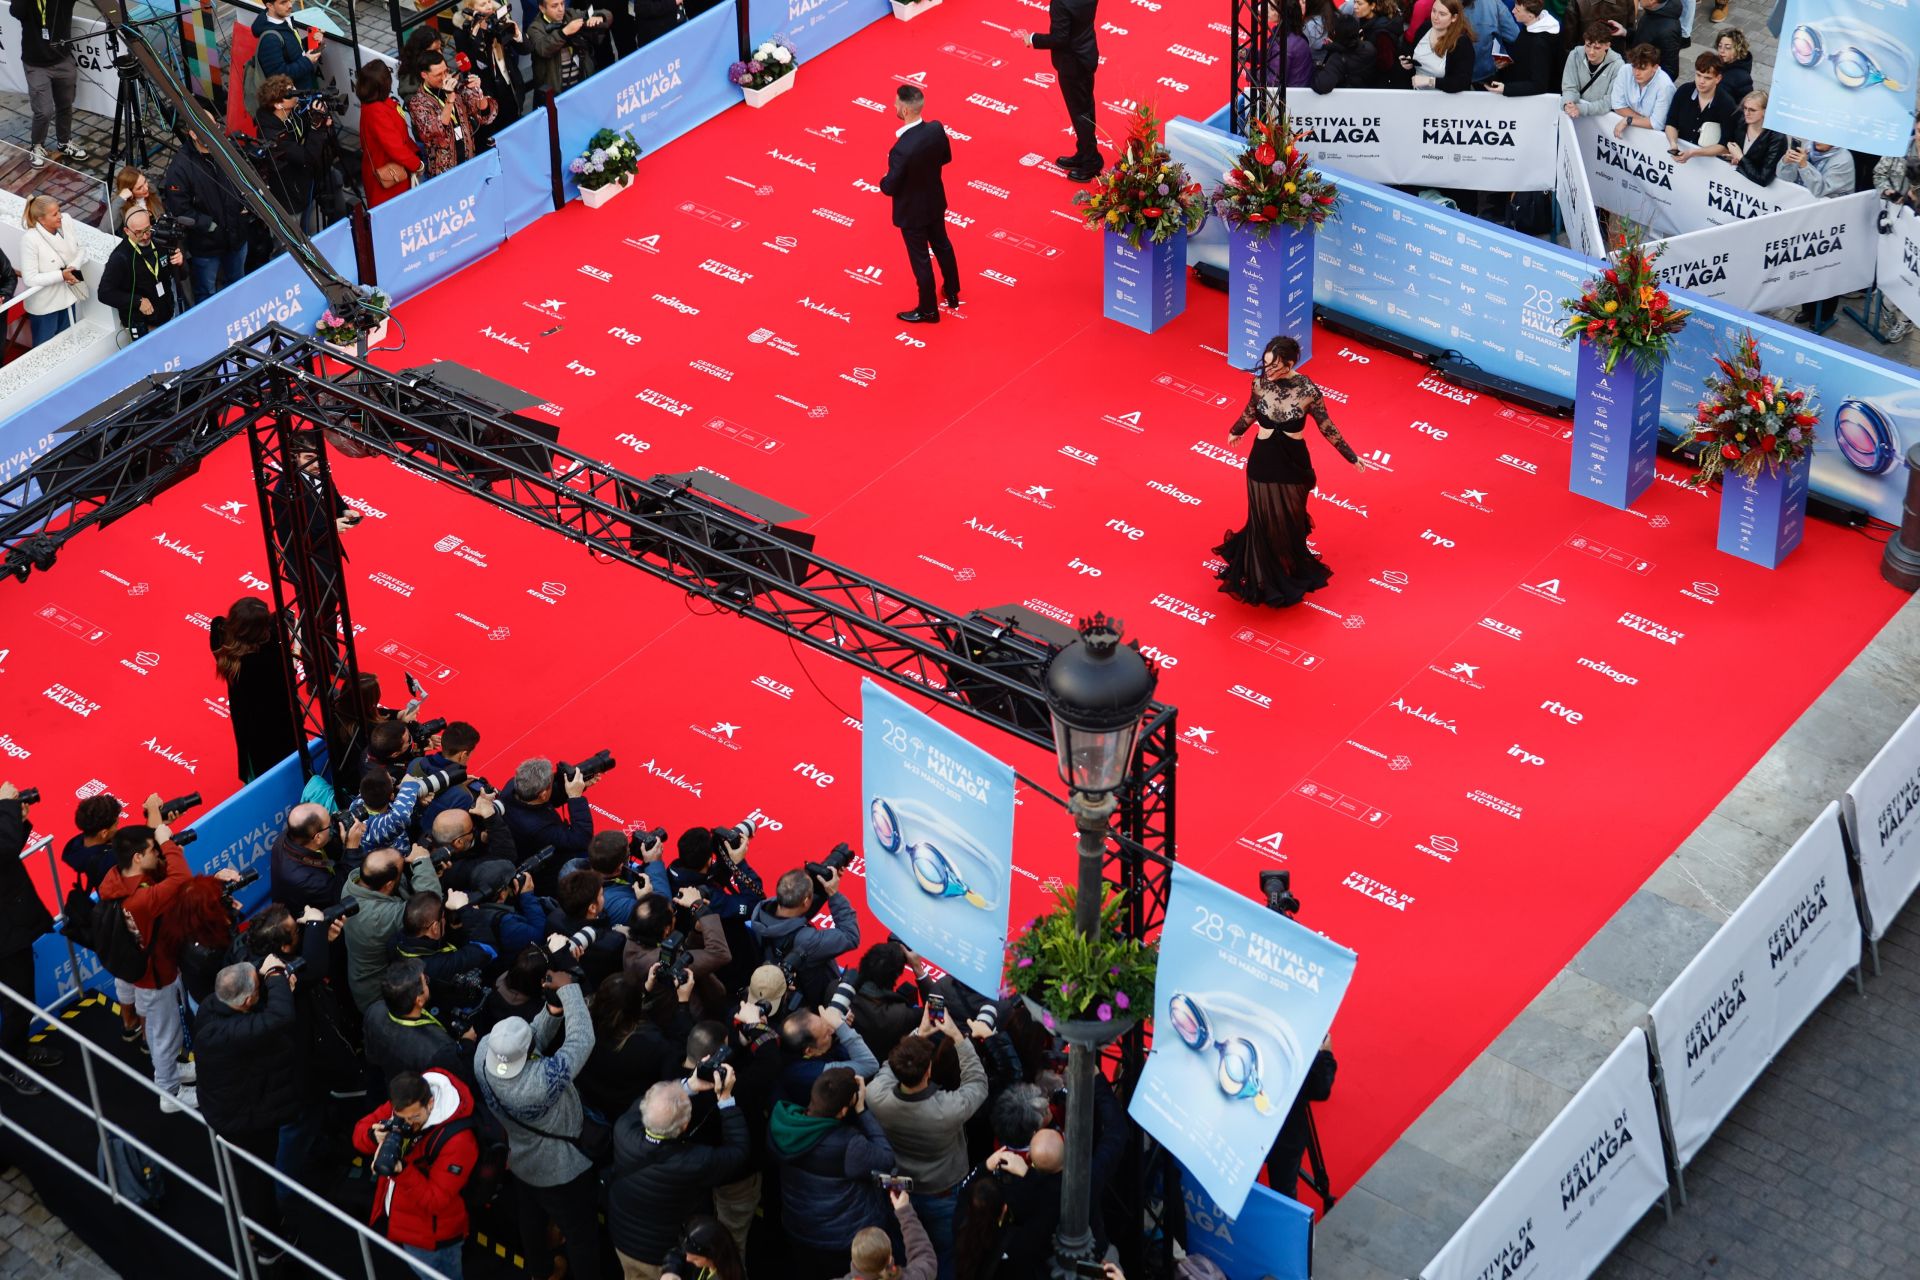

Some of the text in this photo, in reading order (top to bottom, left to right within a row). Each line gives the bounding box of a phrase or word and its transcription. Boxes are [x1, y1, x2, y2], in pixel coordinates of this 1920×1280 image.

[1101, 22, 1128, 35] iryo
[1172, 44, 1205, 57] FESTIVAL
[617, 58, 680, 102] FESTIVAL DE
[1157, 77, 1189, 92] rtve
[856, 98, 886, 110] SUR
[972, 93, 1005, 106] FESTIVAL
[1363, 117, 1381, 127] DE
[1423, 118, 1517, 130] FESTIVAL DE
[1422, 128, 1515, 146] MÁLAGA
[768, 149, 816, 172] Andalucía
[1598, 134, 1674, 174] FESTIVAL DE
[1596, 146, 1672, 190] MÁLAGA
[853, 179, 880, 192] iryo
[968, 182, 1008, 199] VICTORIA
[1709, 180, 1768, 211] FESTIVAL
[400, 194, 476, 240] FESTIVAL DE
[1708, 192, 1767, 220] MÁLA
[812, 210, 853, 227] VICTORIA
[1406, 242, 1422, 256] rtve
[1766, 224, 1846, 252] FESTIVAL DE
[1764, 236, 1842, 269] MÁLAGA
[581, 265, 612, 279] SUR
[705, 259, 739, 275] FESTIVAL
[984, 270, 1016, 284] SUR
[1656, 253, 1729, 279] ESTIVAL DE
[226, 284, 300, 336] FESTIVAL DE
[652, 294, 700, 315] málaga
[799, 297, 850, 322] Andalucía
[1523, 284, 1553, 314] 28
[480, 326, 530, 353] Andalucía
[608, 327, 641, 345] rtve
[896, 332, 925, 347] iryo
[1338, 348, 1369, 363] iryo
[566, 360, 596, 376] iryo
[690, 363, 733, 381] VICTORIA
[839, 373, 868, 387] REPSOL
[1424, 378, 1462, 395] FESTIVAL
[642, 389, 678, 406] FESTIVAL
[1410, 421, 1448, 440] rtve
[615, 433, 650, 452] rtve
[1062, 446, 1098, 462] SUR
[1500, 454, 1537, 471] SUR
[1654, 466, 1710, 497] ndalucía
[1146, 481, 1201, 505] málaga
[1310, 486, 1367, 517] Andalucía
[339, 495, 387, 522] málaga
[965, 517, 1022, 548] Andalucía
[1106, 519, 1144, 540] rtve
[1421, 529, 1454, 547] iryo
[153, 532, 204, 564] Andalucía
[1068, 558, 1101, 576] iryo
[239, 572, 269, 590] iryo
[369, 575, 413, 597] VICTORIA
[1369, 577, 1402, 593] REPSOL
[527, 588, 556, 604] REPSOL
[1157, 594, 1215, 619] FESTIVAL DE
[1680, 588, 1714, 604] REPSOL
[1024, 602, 1073, 624] VICTORIA
[1482, 618, 1522, 636] SUR
[1624, 612, 1684, 639] FESTIVAL DE
[121, 658, 149, 675] REPSOL
[1140, 646, 1177, 668] rtve
[1577, 658, 1638, 685] málaga
[756, 676, 794, 695] SUR
[1232, 685, 1272, 705] SUR
[49, 684, 100, 711] FESTIVAL DE
[1391, 698, 1456, 734] Andalucía
[1541, 701, 1582, 724] rtve
[0, 734, 31, 761] álaga
[143, 737, 197, 774] Andalucía
[882, 719, 991, 790] 28 FESTIVAL DE
[1507, 744, 1544, 765] iryo
[642, 759, 702, 798] Andalucía
[793, 763, 834, 787] rtve
[1467, 793, 1521, 819] VICTORIA
[746, 808, 782, 834] iryo
[204, 822, 270, 875] FESTIVAL
[1415, 843, 1452, 863] REPSOL
[1350, 872, 1415, 904] FESTIVAL DE
[1768, 895, 1811, 950] FESTIVAL
[1813, 875, 1826, 898] DE
[1192, 906, 1325, 977] 28 FESTIVAL DE
[1685, 990, 1729, 1049] FESTIVAL
[1731, 970, 1745, 992] DE
[1560, 1130, 1610, 1191] FESTIVAL
[1614, 1108, 1628, 1130] DE
